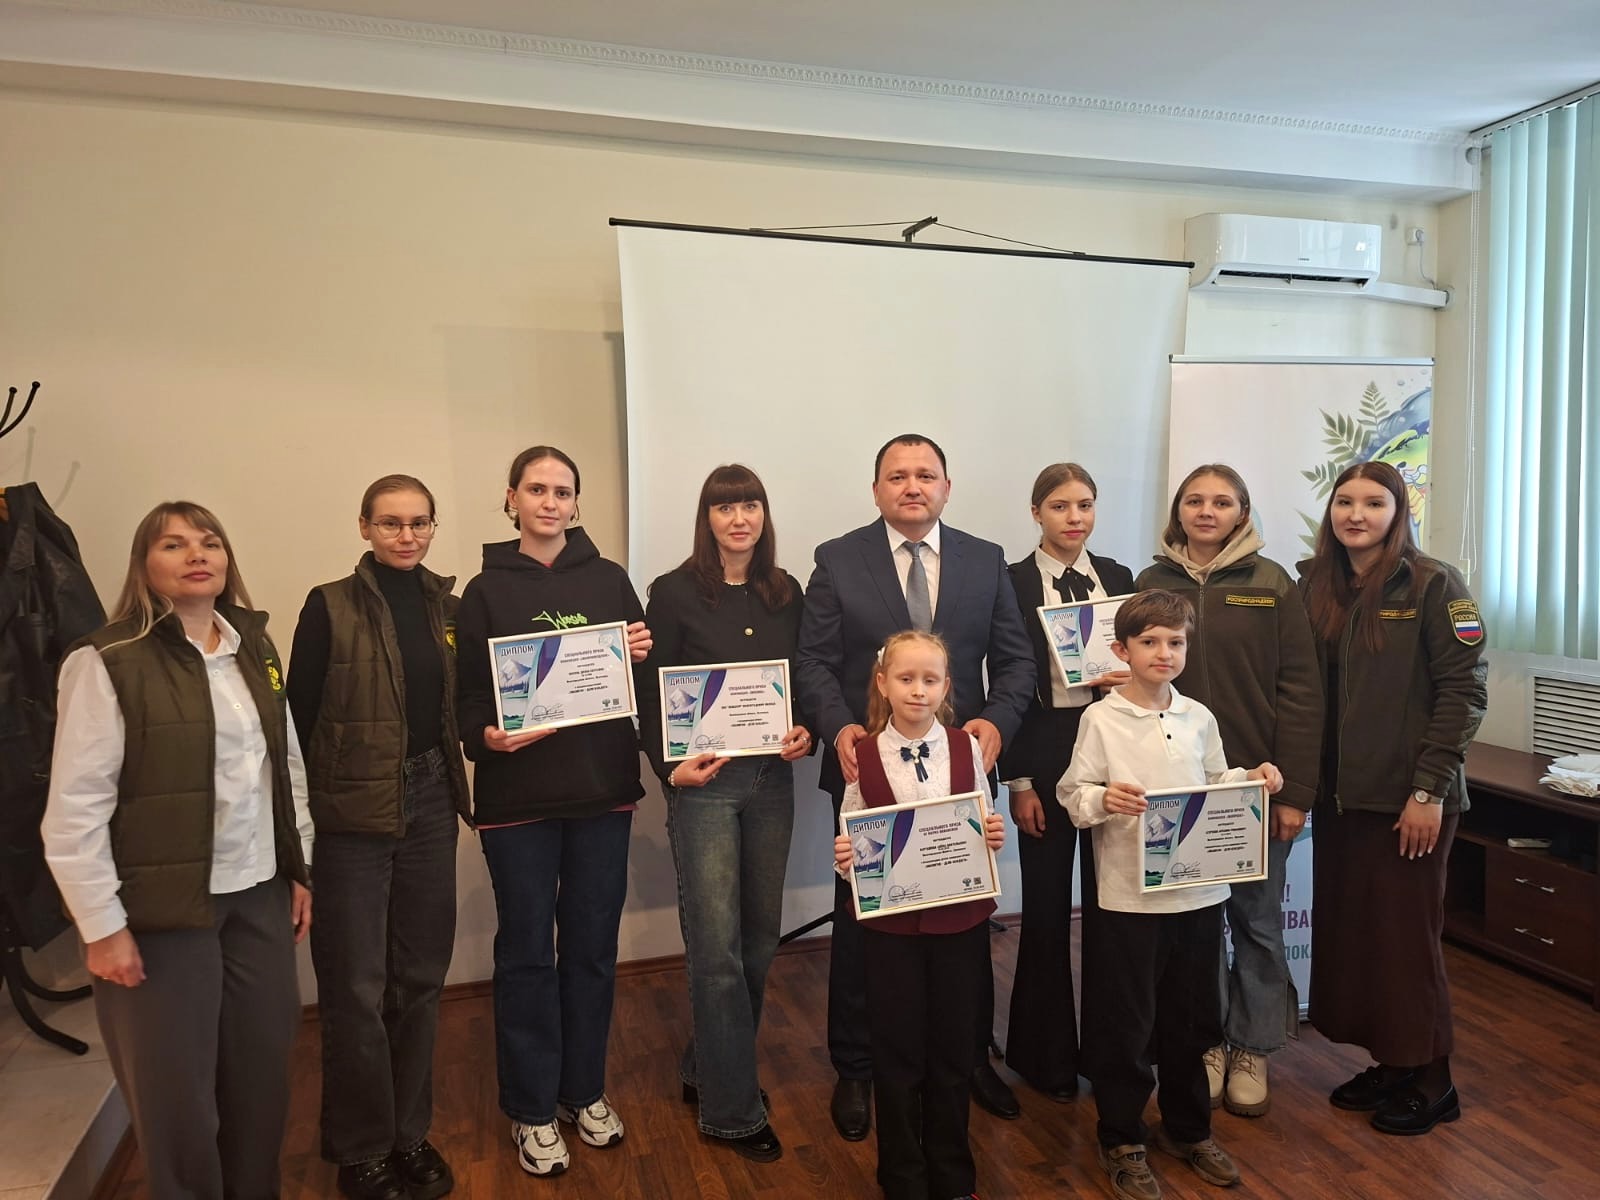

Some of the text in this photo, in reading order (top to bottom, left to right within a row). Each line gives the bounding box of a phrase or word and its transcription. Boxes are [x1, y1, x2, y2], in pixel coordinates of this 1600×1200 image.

[1454, 613, 1477, 621] РОССИЯ
[501, 645, 533, 656] ДИПЛОМ
[670, 676, 700, 686] ДИПЛОМ
[1149, 800, 1180, 811] ДИПЛОМ
[853, 819, 887, 833] ДИПЛОМ
[1281, 909, 1312, 930] ВА
